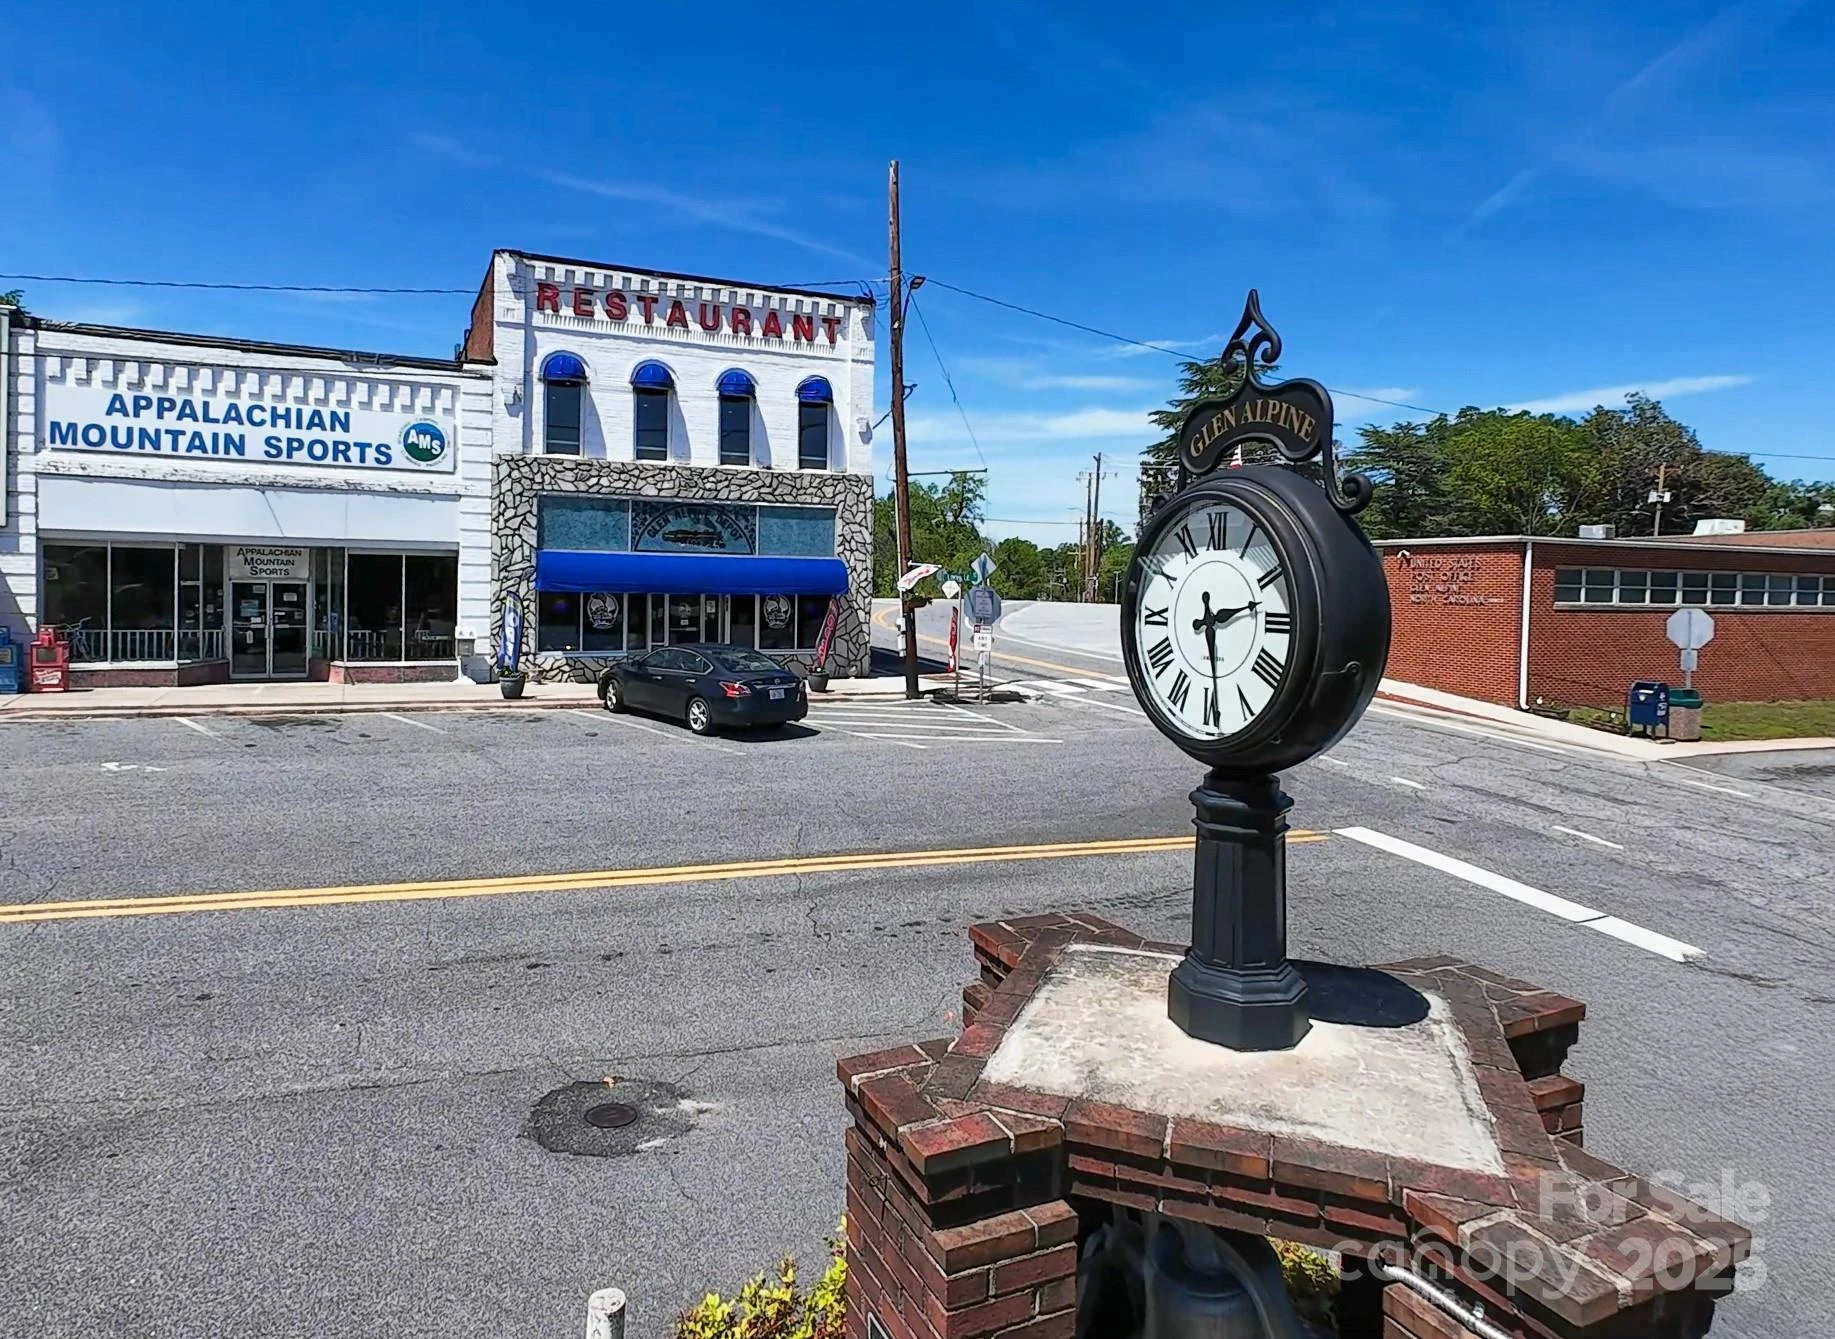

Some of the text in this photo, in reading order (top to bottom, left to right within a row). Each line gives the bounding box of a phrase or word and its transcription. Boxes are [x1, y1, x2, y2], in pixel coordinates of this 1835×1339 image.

[536, 281, 842, 345] RESTAURANT
[105, 393, 350, 433] APPALACHIAN
[407, 428, 442, 455] AMS
[1190, 399, 1316, 457] GLEN ALPINE
[50, 420, 246, 457] MOUNTAIN
[263, 435, 393, 466] SPORTS
[646, 514, 672, 539] GLEN
[716, 514, 743, 541] DEPOT
[237, 547, 302, 557] APPALACHIAN
[244, 556, 295, 566] MOUNTAIN
[249, 566, 290, 576] SPORTS
